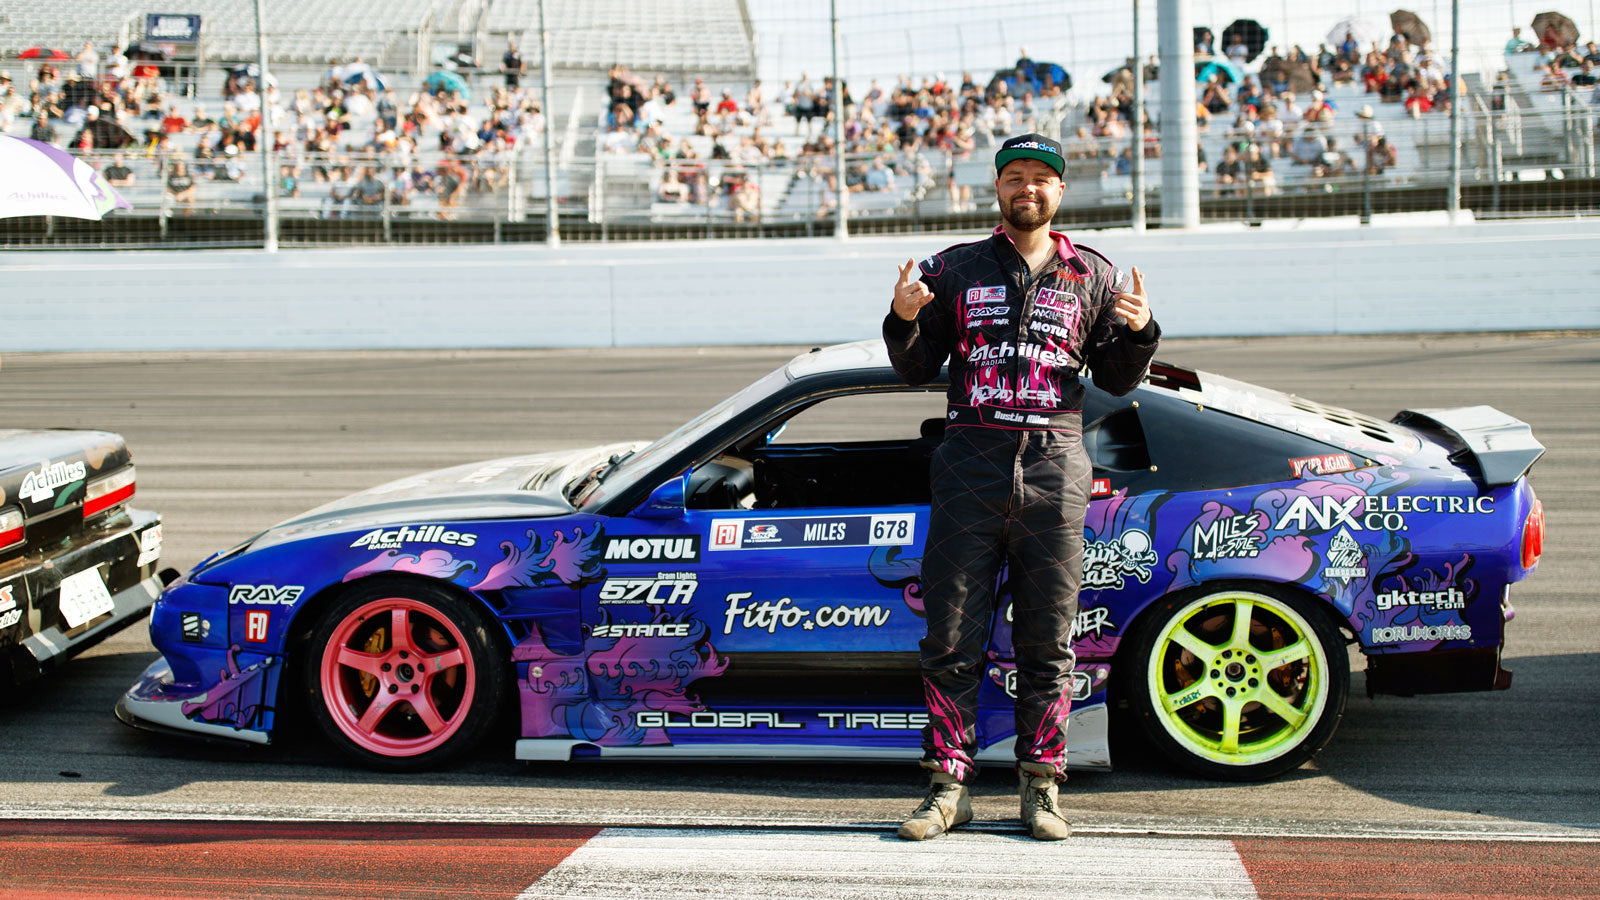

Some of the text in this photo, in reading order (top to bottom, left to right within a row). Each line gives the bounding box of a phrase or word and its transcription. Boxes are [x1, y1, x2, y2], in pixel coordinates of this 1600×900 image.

[967, 306, 1010, 318] RAYS
[1030, 320, 1068, 339] MOTUL
[967, 341, 1069, 367] Achilles
[980, 358, 1007, 367] RADIAL
[994, 410, 1050, 425] Dustin Miles
[20, 463, 85, 495] Achilles
[1365, 496, 1495, 514] ELECTRIC
[1365, 513, 1409, 532] CO.
[349, 525, 478, 549] Achilles
[717, 525, 736, 545] FD
[803, 522, 847, 542] MILES
[873, 519, 908, 539] 678
[1194, 514, 1260, 561] MILES
[368, 541, 402, 550] RADIAL
[604, 538, 696, 560] MOTUL
[657, 572, 697, 581] Gram Lights
[230, 586, 303, 604] RAYS
[1376, 588, 1464, 610] gktech
[723, 592, 891, 635] Fitfo.com
[1431, 602, 1465, 610] .com
[248, 612, 268, 640] FD
[608, 624, 690, 637] STANCE
[1372, 625, 1472, 643] KORUWORKS
[636, 712, 930, 728] GLOBAL TIRES
